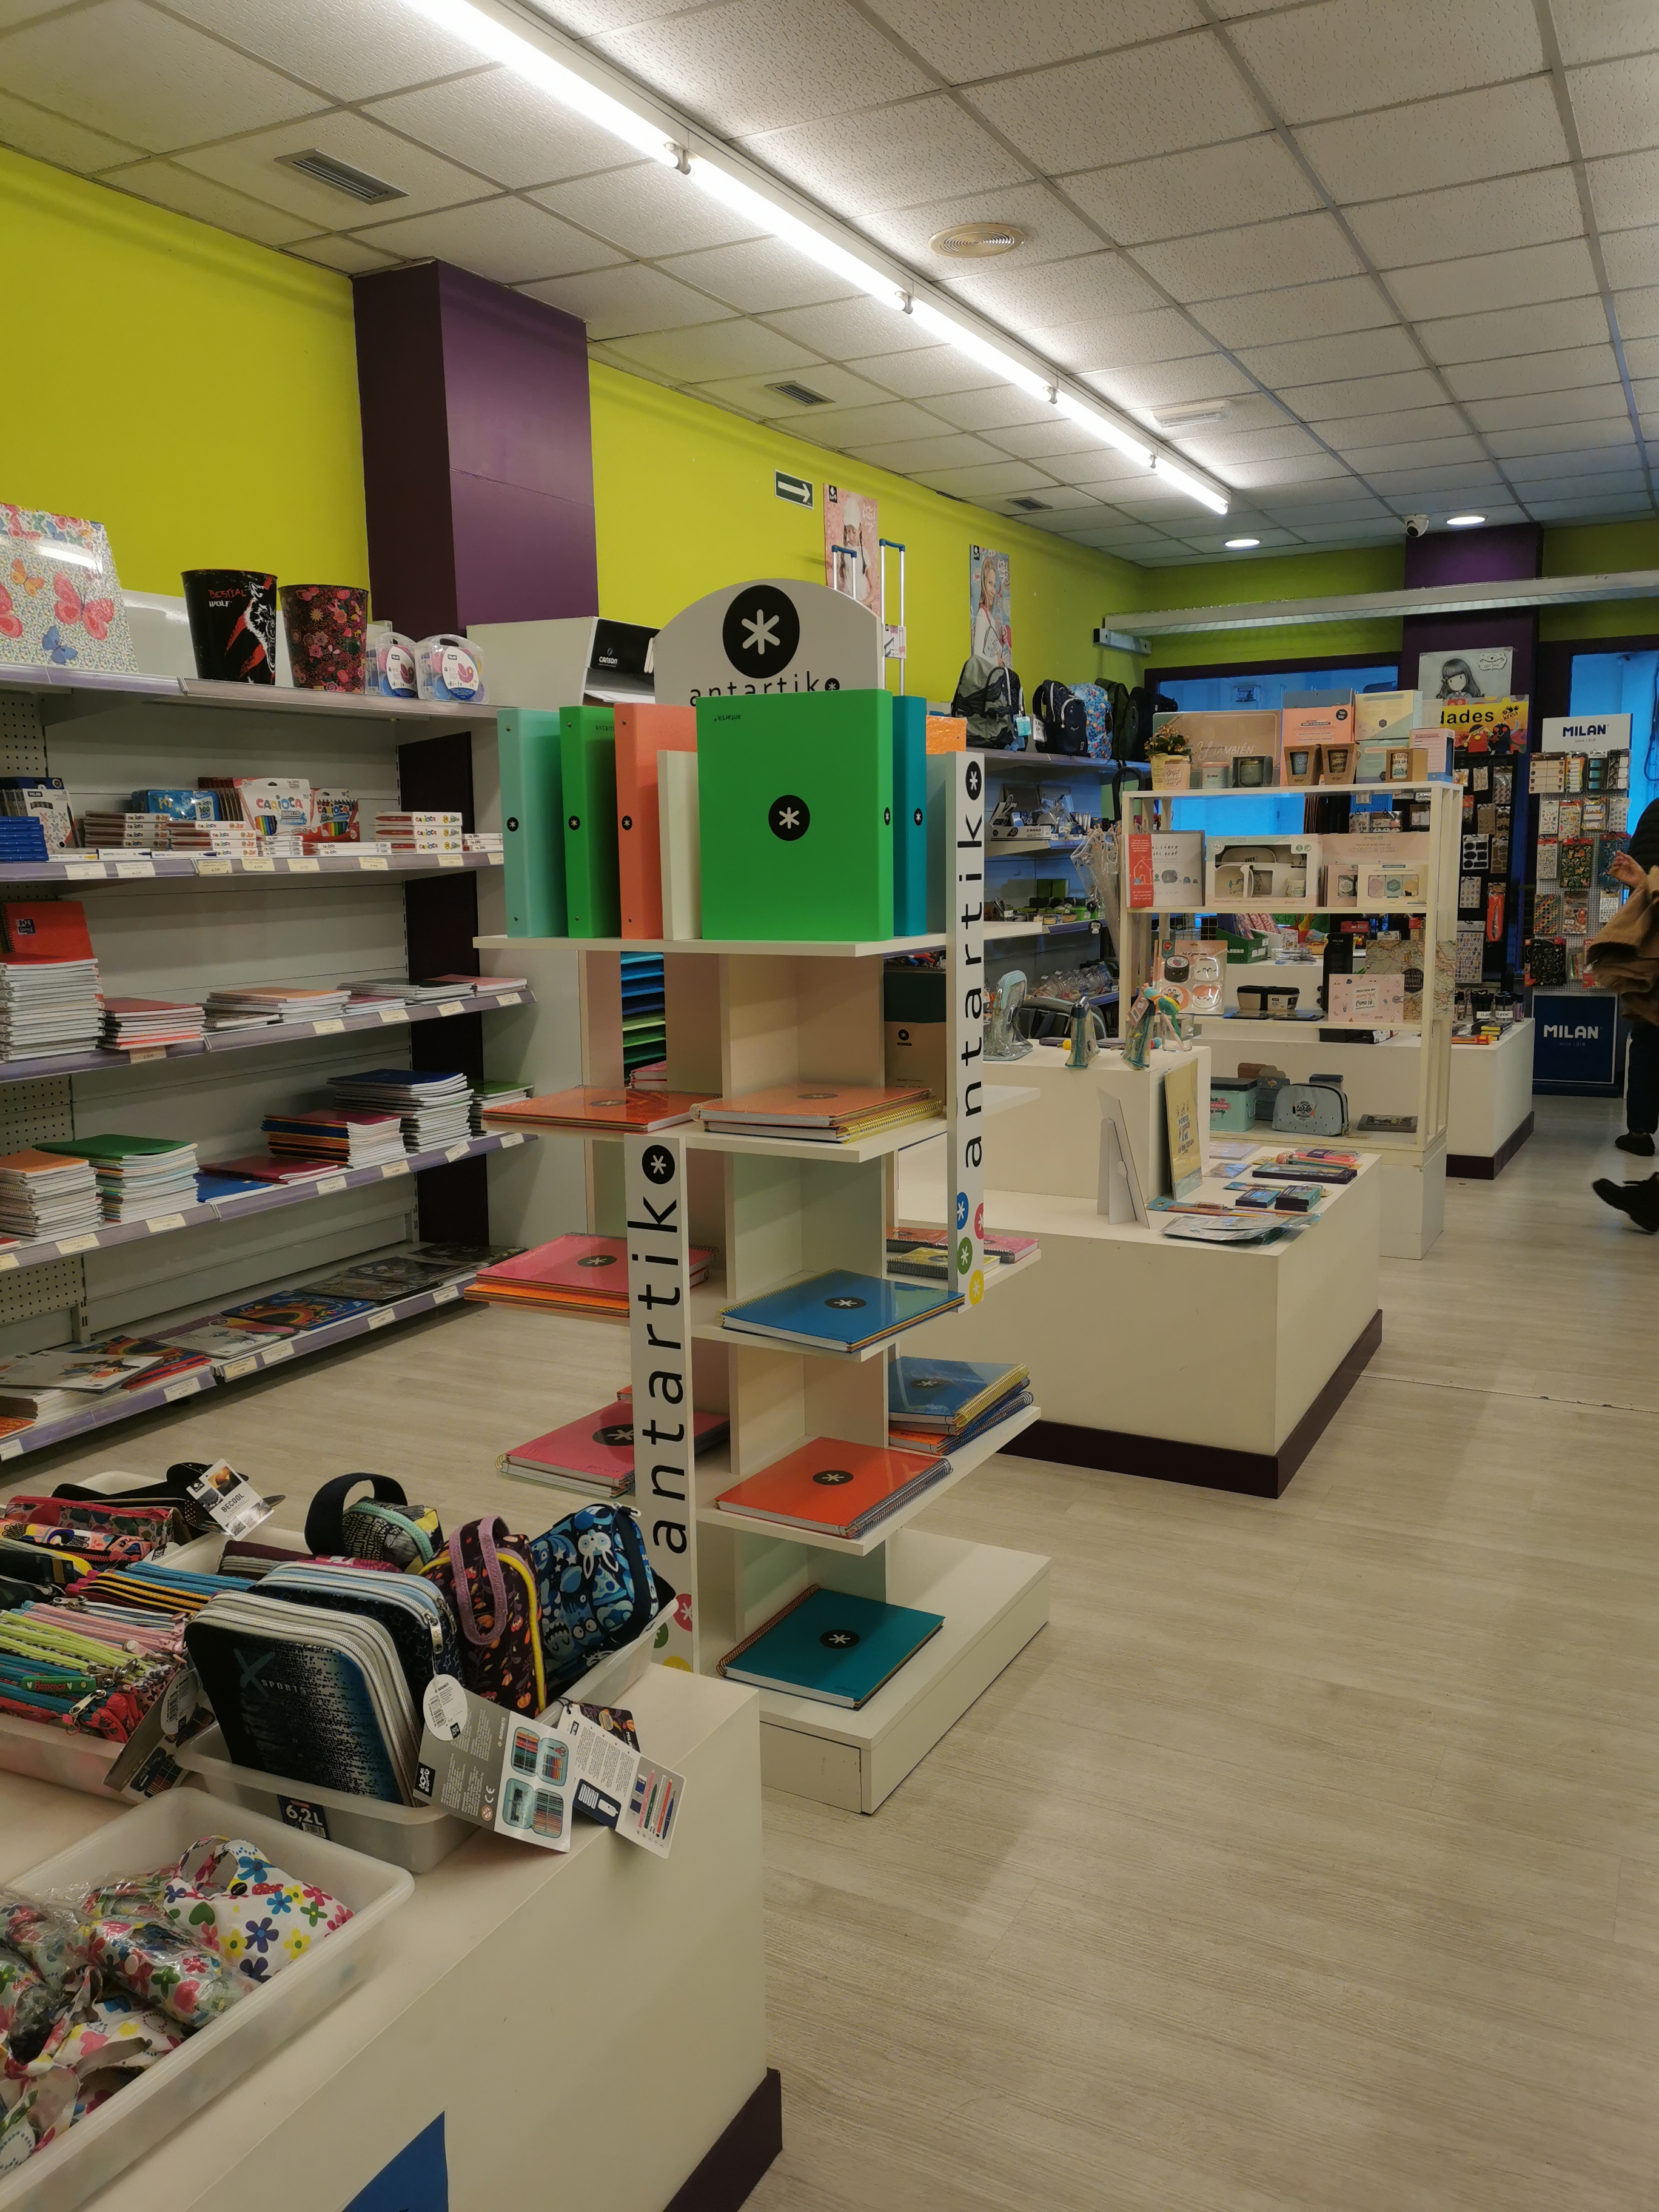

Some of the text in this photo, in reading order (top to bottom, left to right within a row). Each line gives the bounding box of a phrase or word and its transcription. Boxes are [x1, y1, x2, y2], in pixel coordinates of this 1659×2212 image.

[208, 588, 247, 598] BESTIAL
[599, 656, 617, 665] CANSON
[1563, 724, 1606, 737] MILAN
[256, 794, 303, 811] CARIOCA
[317, 805, 347, 814] CARIOCA
[1543, 1024, 1599, 1039] MILAN
[221, 1493, 245, 1513] BECOOL
